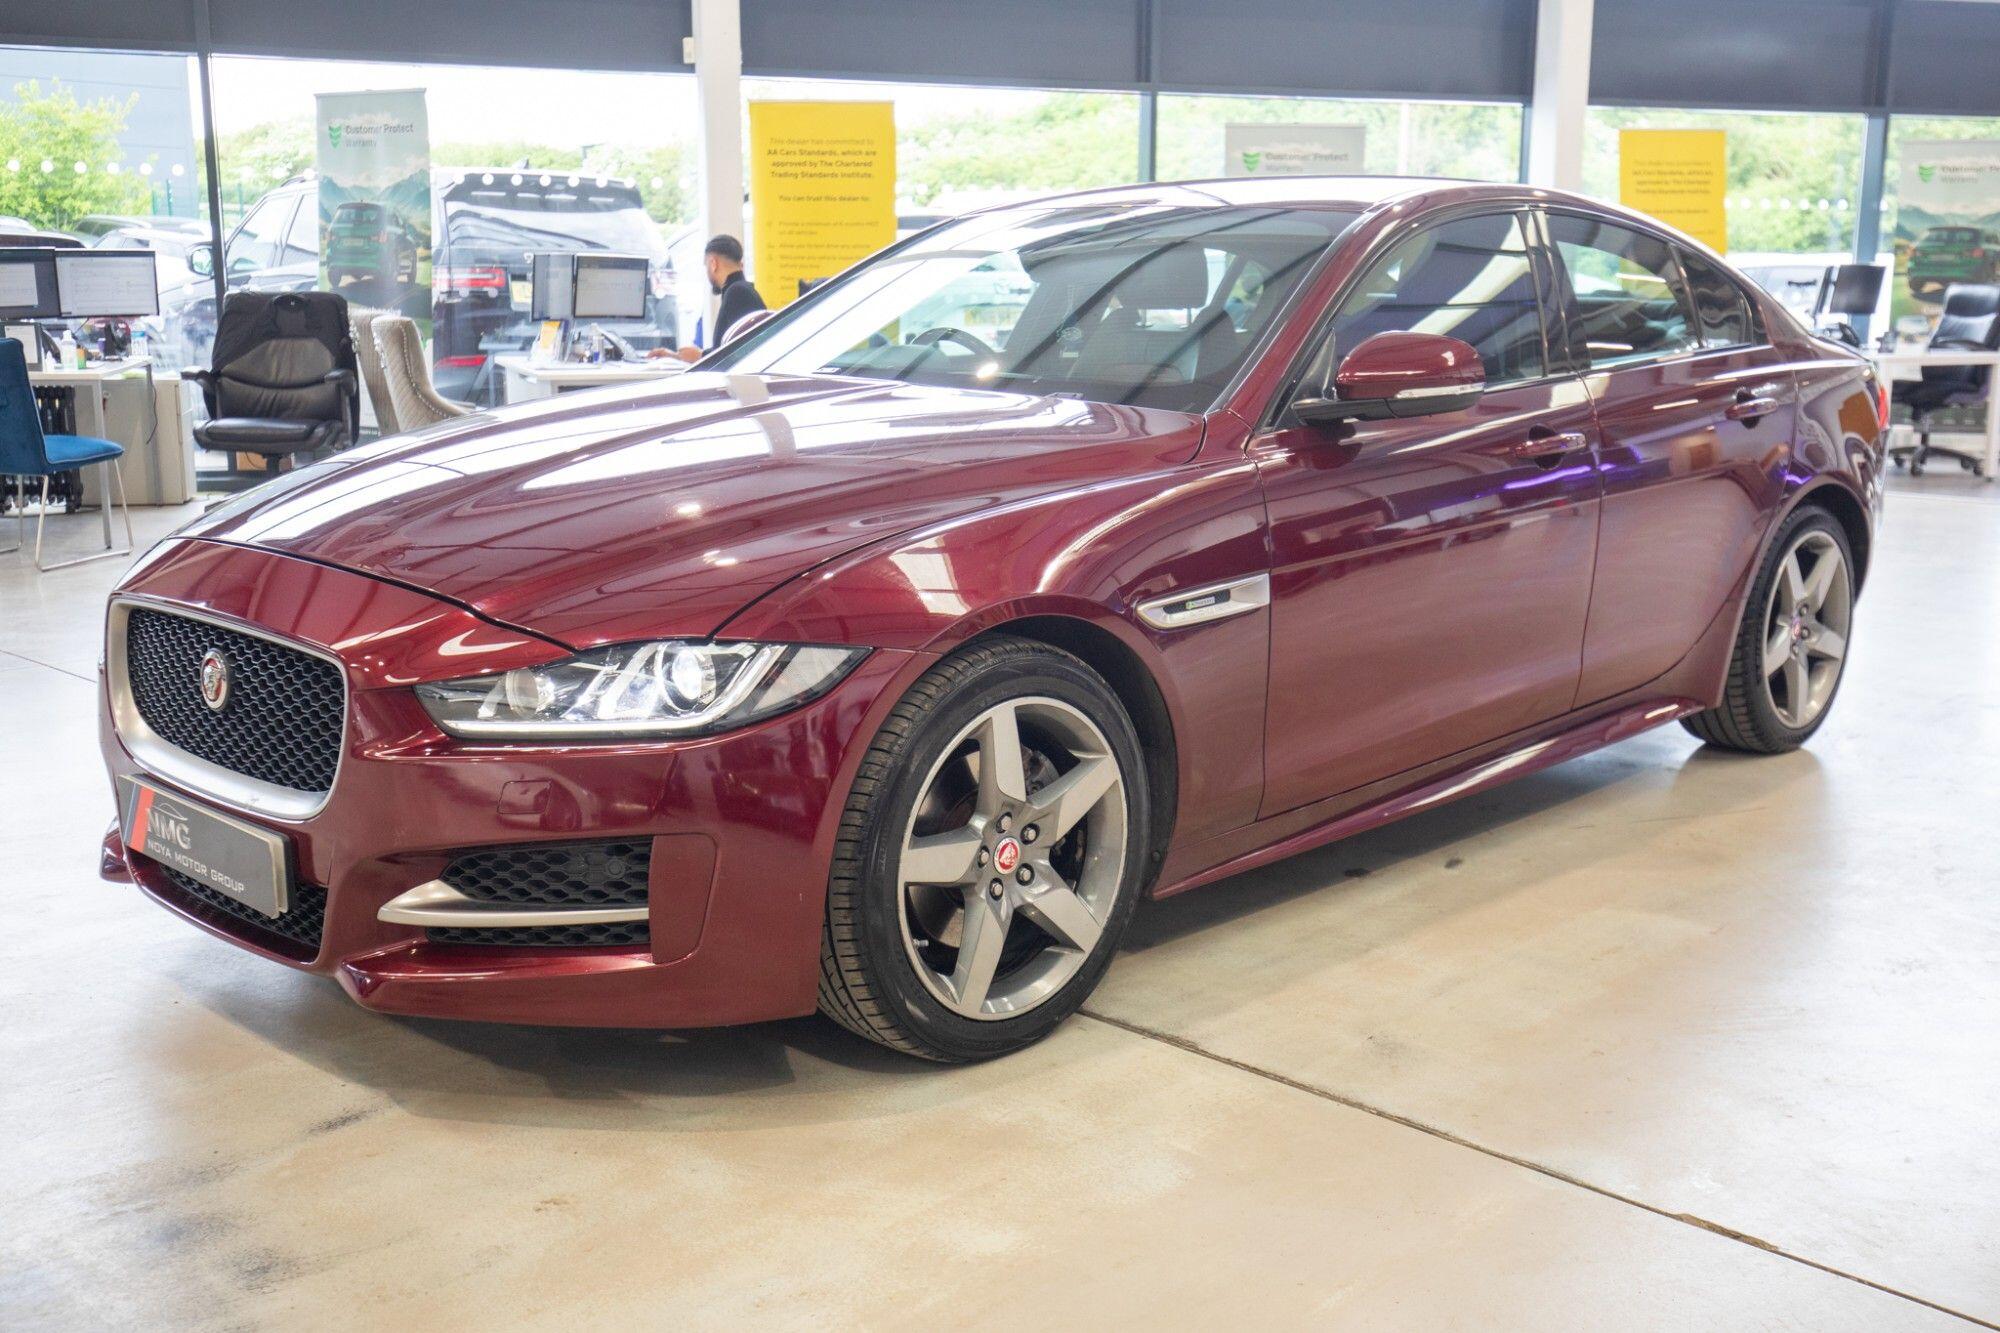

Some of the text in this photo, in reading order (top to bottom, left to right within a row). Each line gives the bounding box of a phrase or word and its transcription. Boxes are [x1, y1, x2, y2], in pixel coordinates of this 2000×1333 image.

[383, 122, 414, 134] Protect
[146, 808, 191, 849] NMG
[174, 852, 208, 876] MOTOR
[210, 869, 244, 893] GROUP
